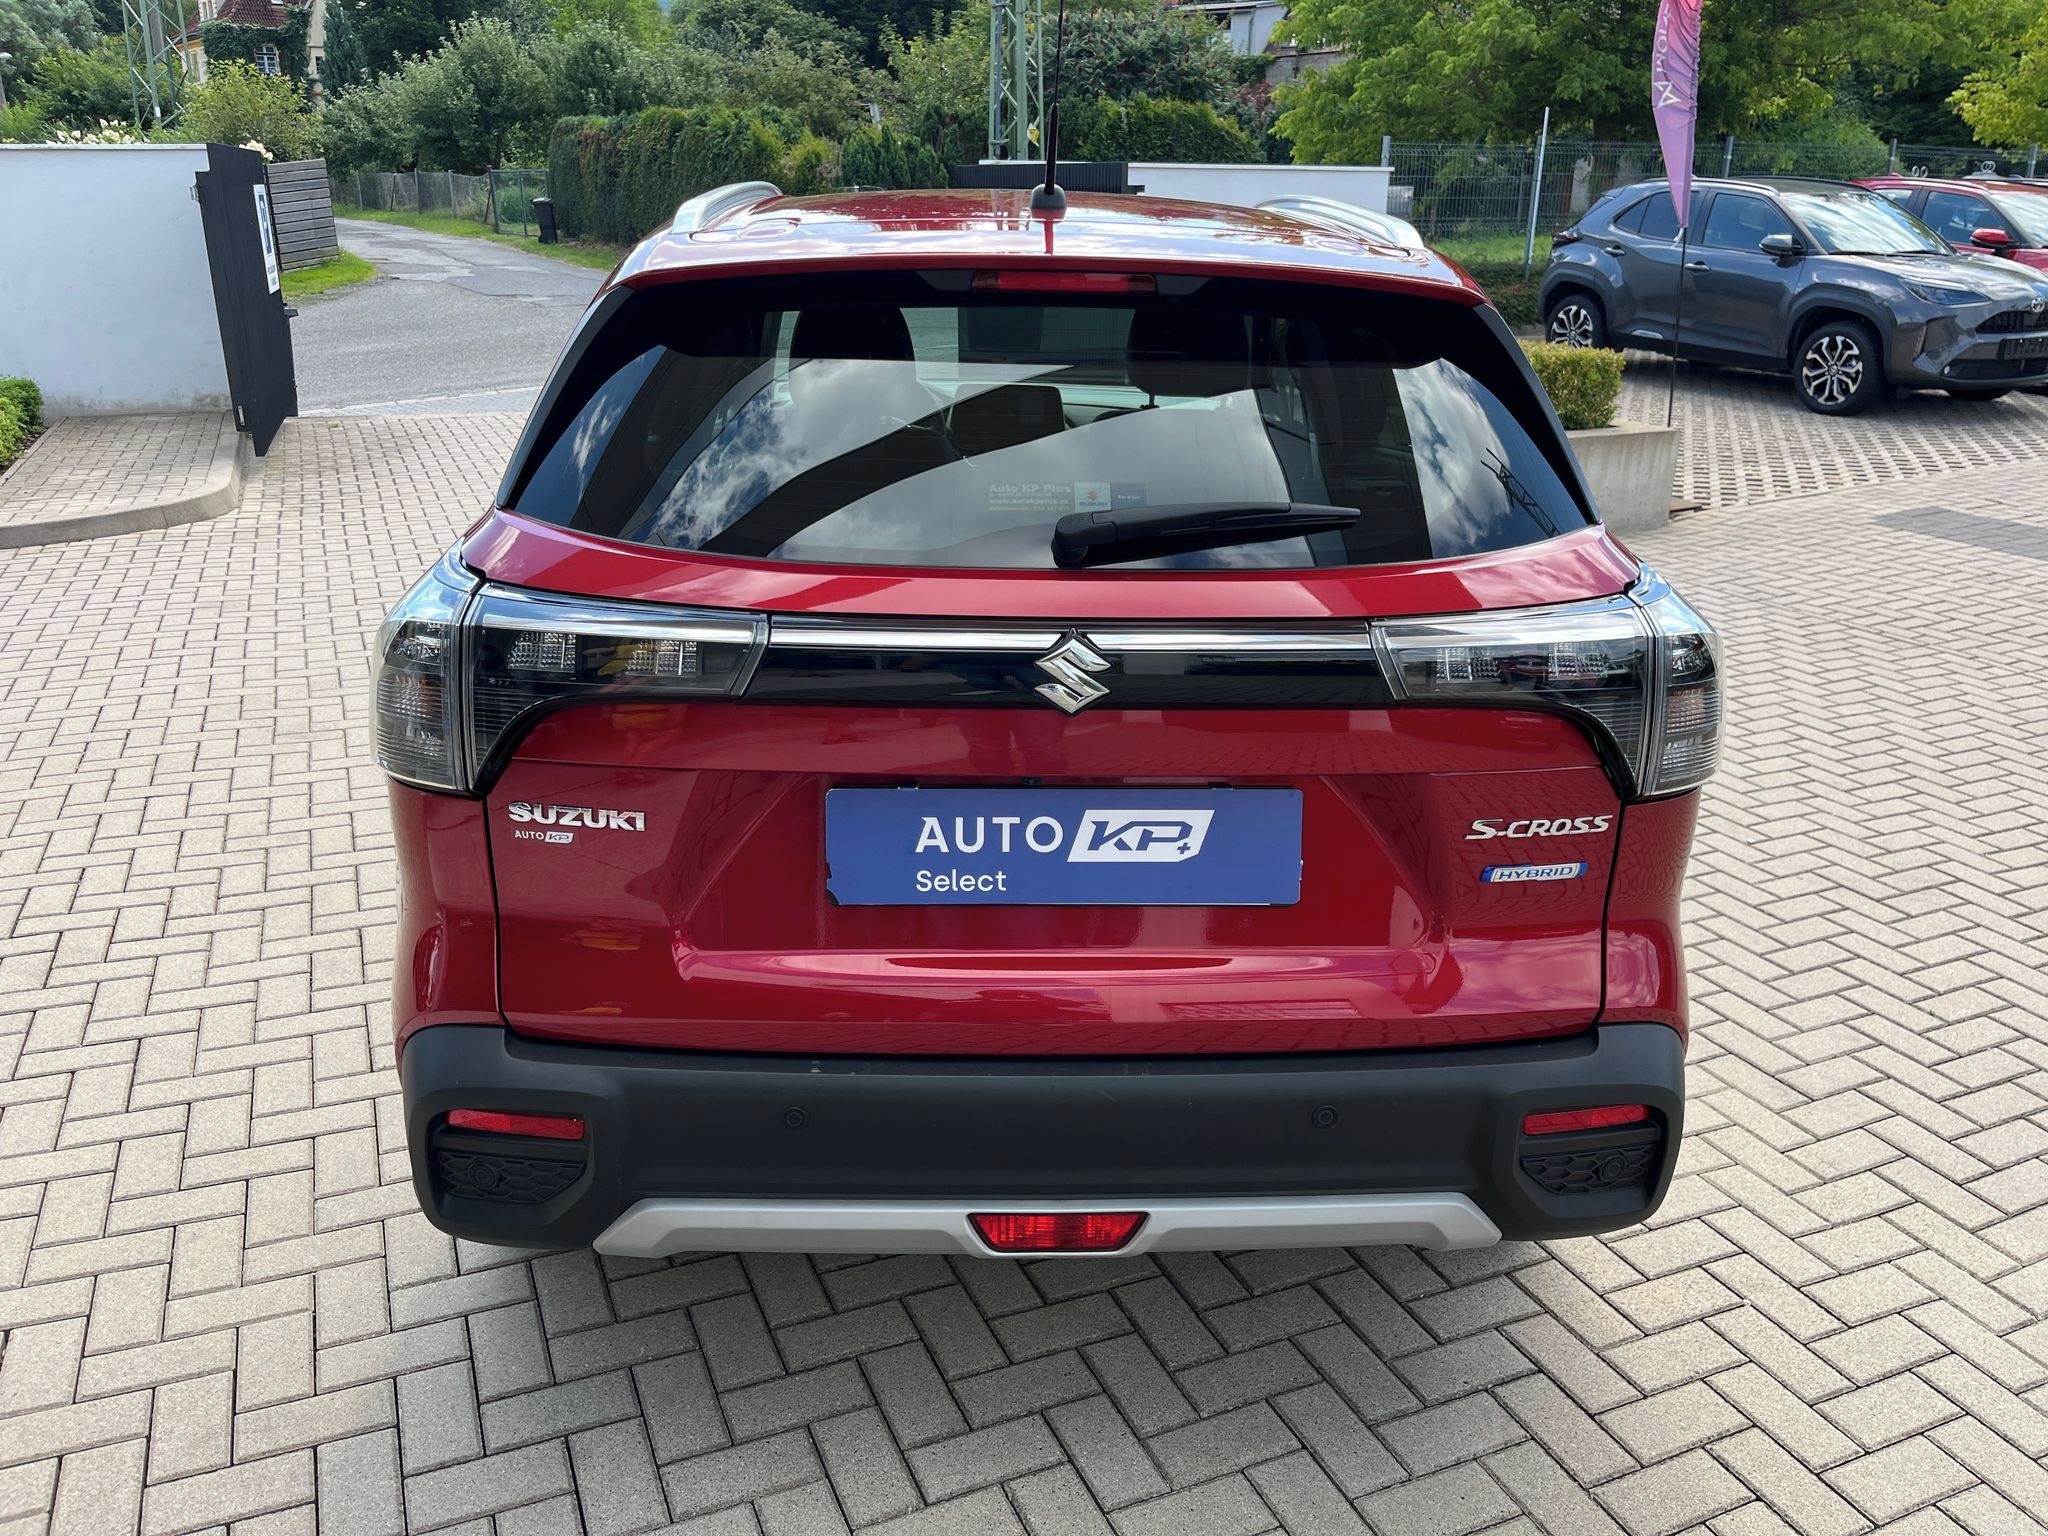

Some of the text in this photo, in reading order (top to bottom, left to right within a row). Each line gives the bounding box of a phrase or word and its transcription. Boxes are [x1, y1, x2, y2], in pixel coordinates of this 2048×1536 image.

[988, 483, 1072, 493] Auto KP Plus
[508, 801, 646, 832] SUZUKI
[1464, 814, 1614, 840] S-CROSS
[514, 830, 545, 841] AUTO
[914, 815, 1064, 854] AUTO
[915, 868, 1008, 893] Select
[1498, 866, 1573, 880] HYBRID
